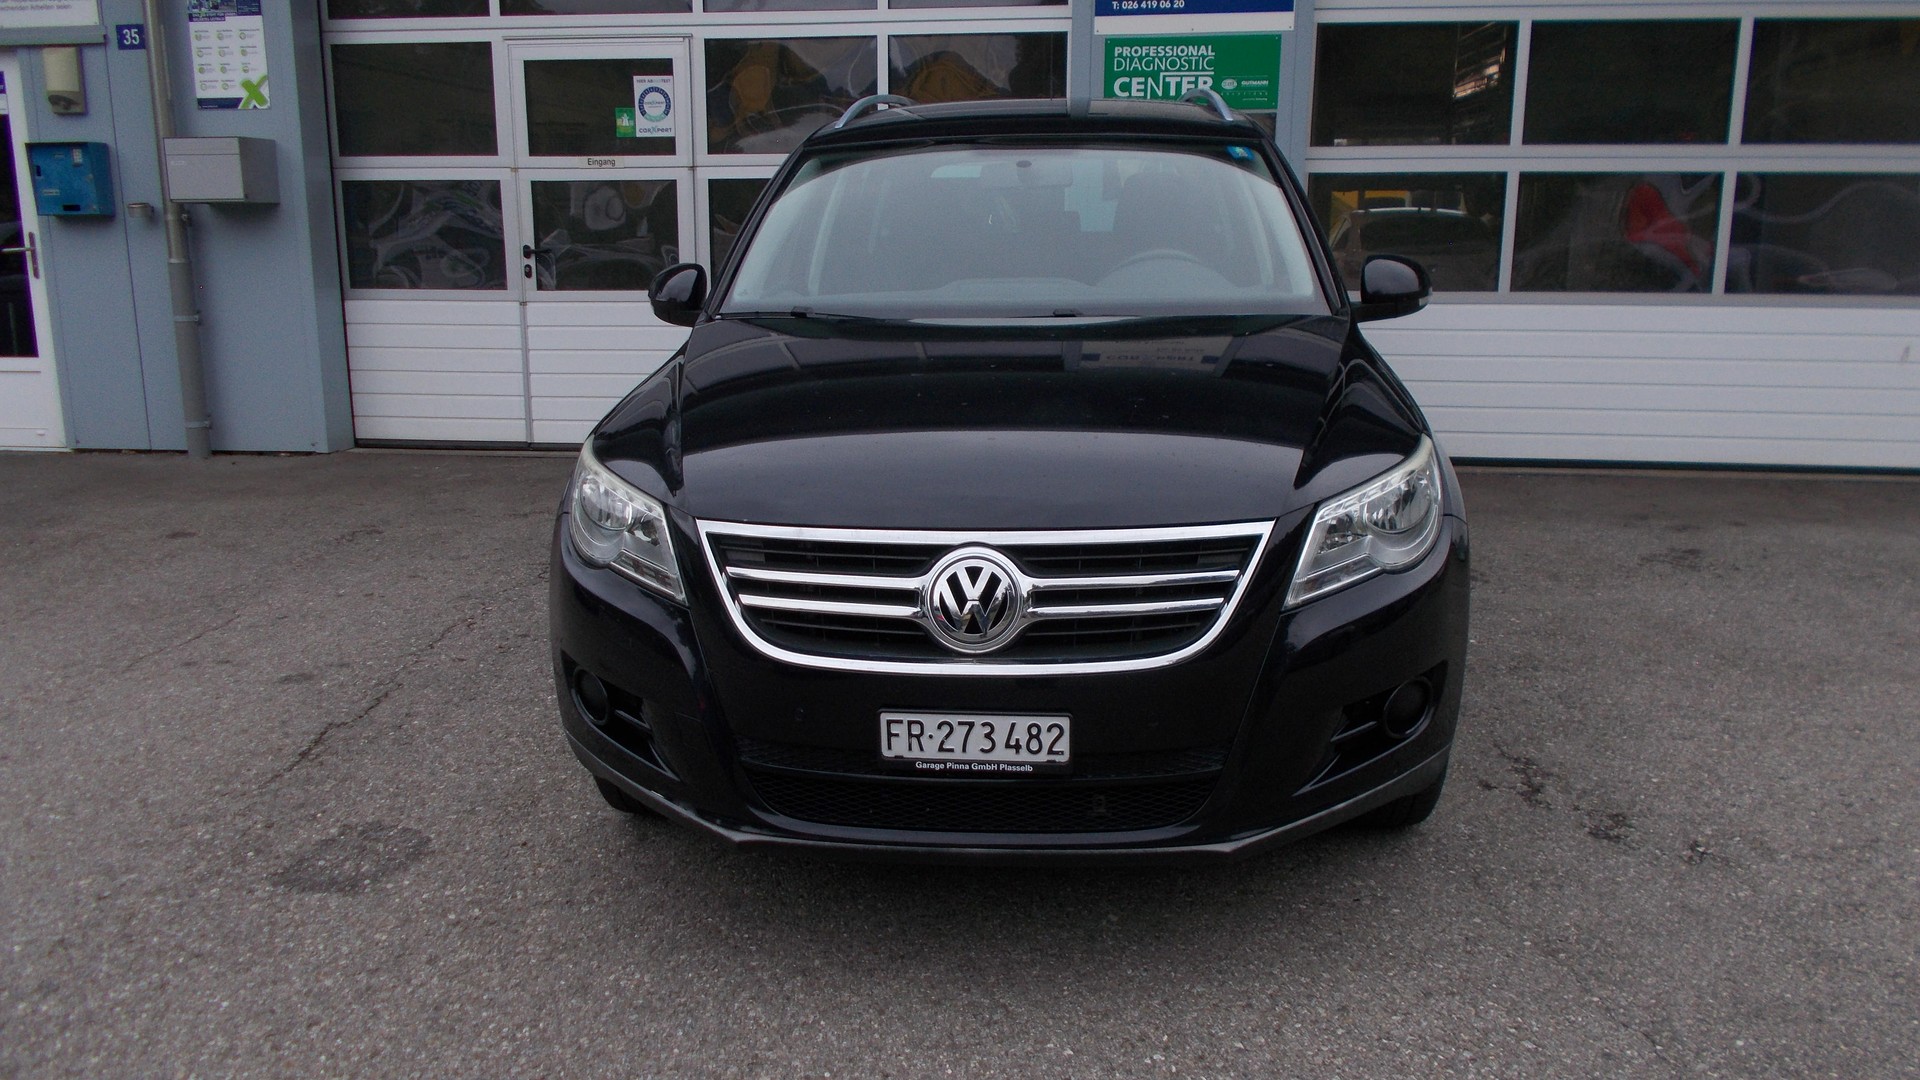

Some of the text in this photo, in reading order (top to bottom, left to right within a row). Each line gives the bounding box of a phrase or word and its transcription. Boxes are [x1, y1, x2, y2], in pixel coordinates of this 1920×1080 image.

[1122, 1, 1139, 9] 026
[1141, 0, 1158, 9] 419
[1160, 0, 1171, 8] 06
[1173, 0, 1185, 8] 20
[123, 29, 140, 45] 35
[1114, 45, 1215, 57] PROFESSIONAL
[1113, 56, 1215, 71] DIAGNOSTIC
[1113, 73, 1214, 99] CENTER
[587, 157, 616, 168] Eingang
[915, 761, 1034, 772] Garage Pinna GmbH Plasselb
